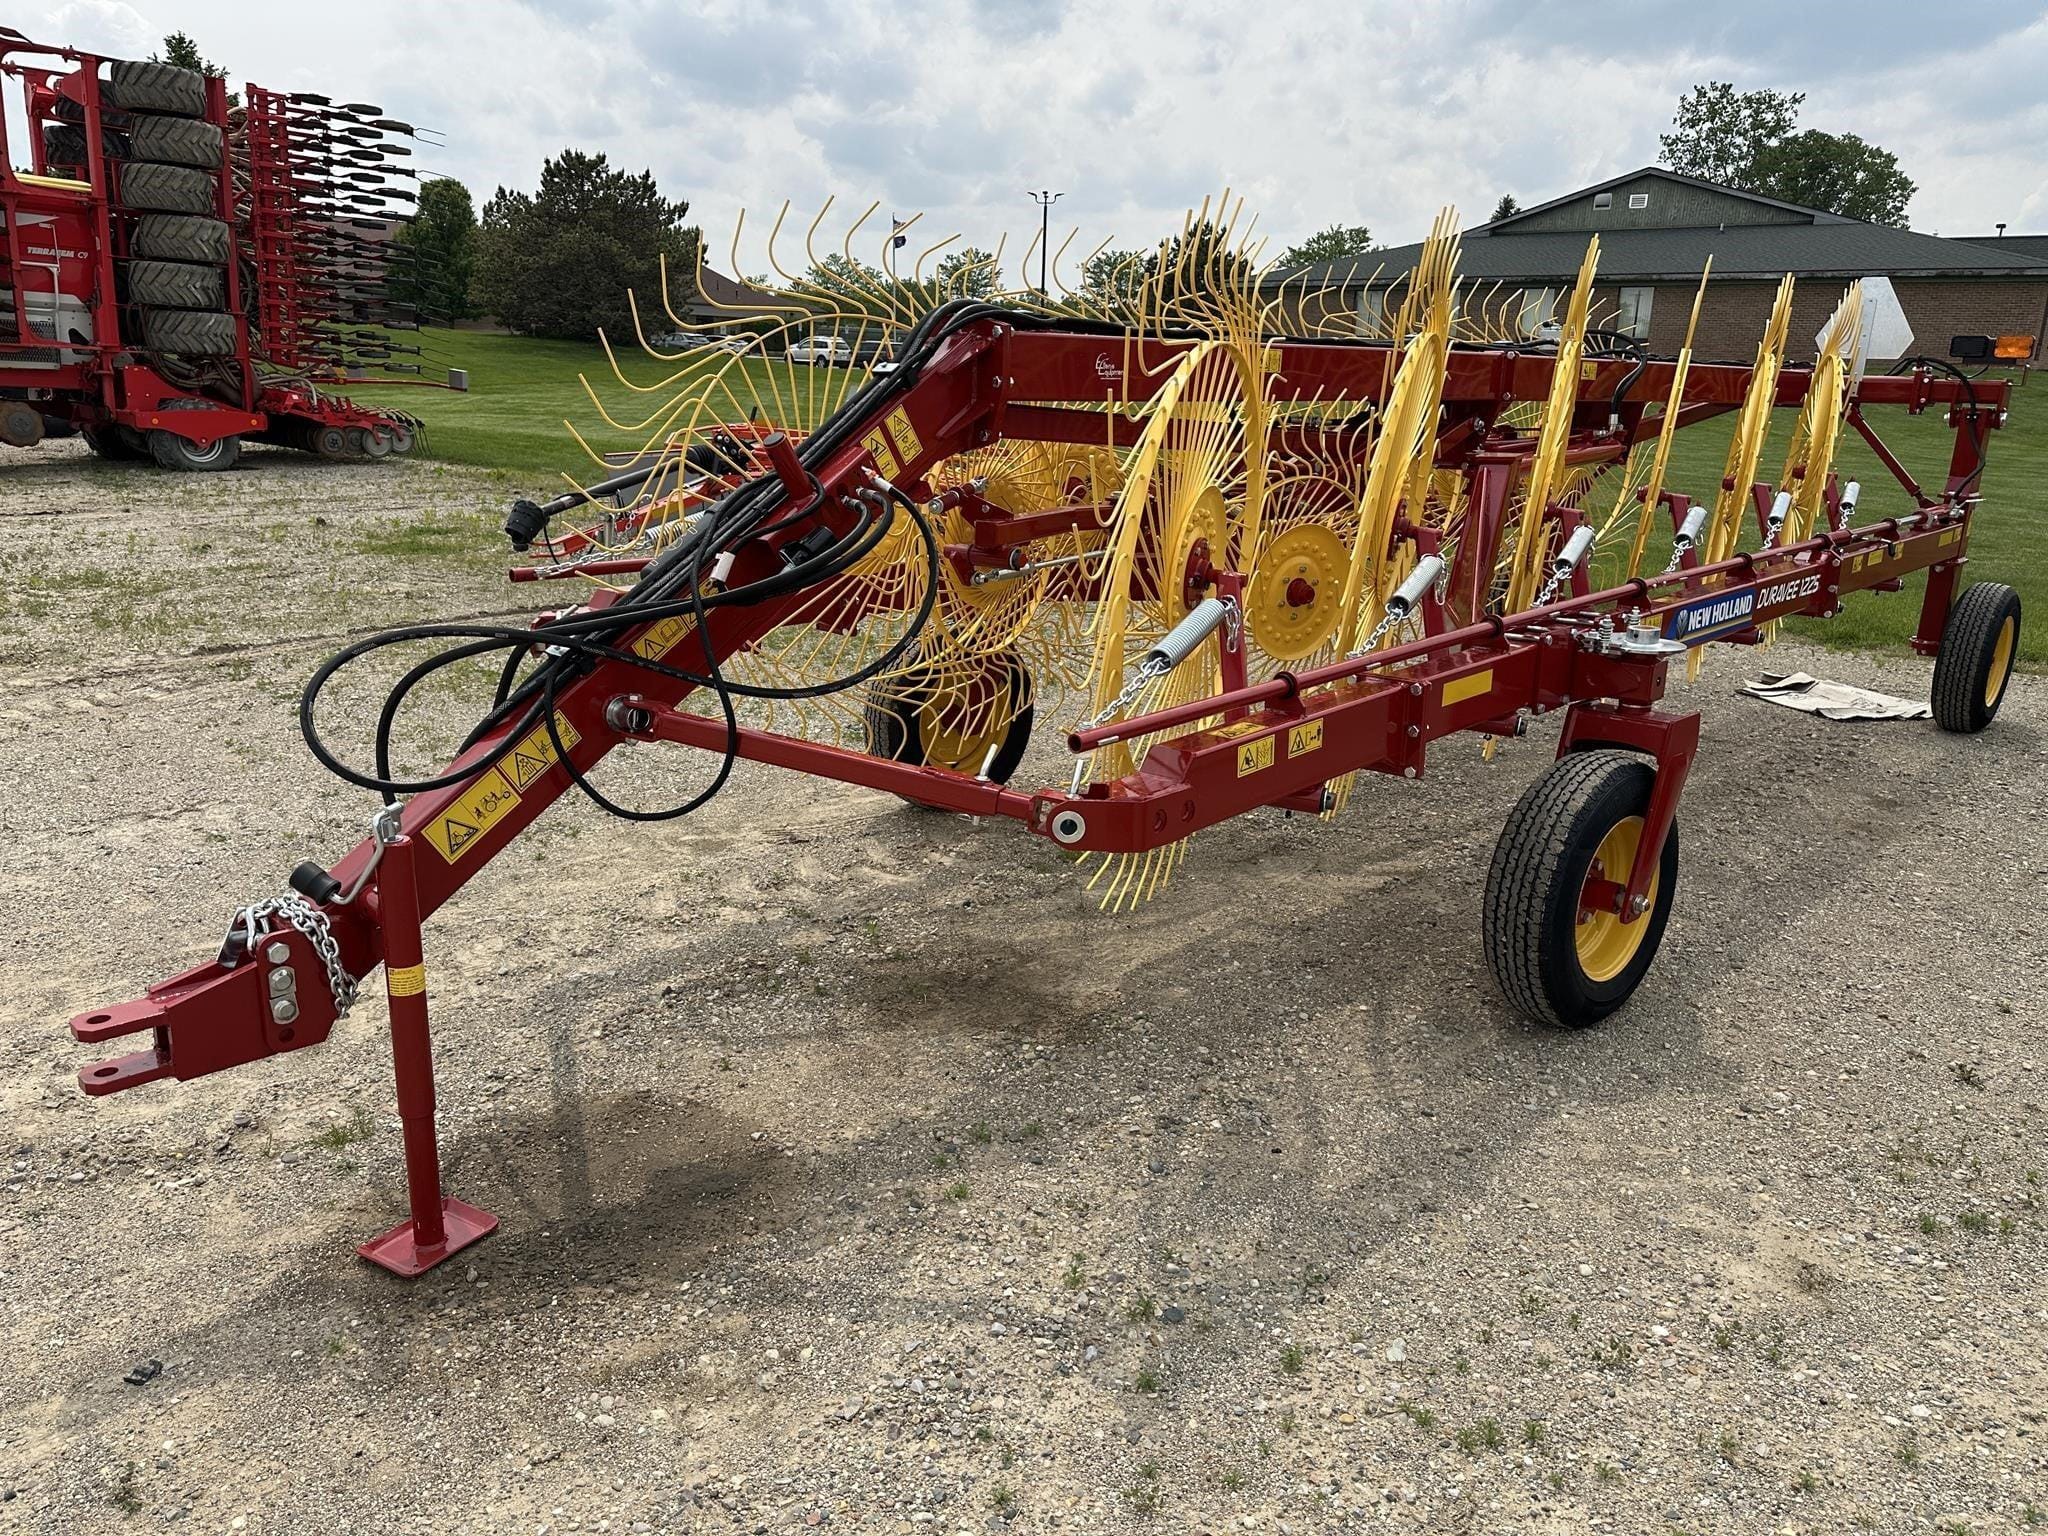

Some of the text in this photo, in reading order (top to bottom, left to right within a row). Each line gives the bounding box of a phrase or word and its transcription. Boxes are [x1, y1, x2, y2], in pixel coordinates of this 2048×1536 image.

[1756, 574, 1822, 610] DURAVEE 1225
[1688, 594, 1753, 632] NEW HOLLAND
